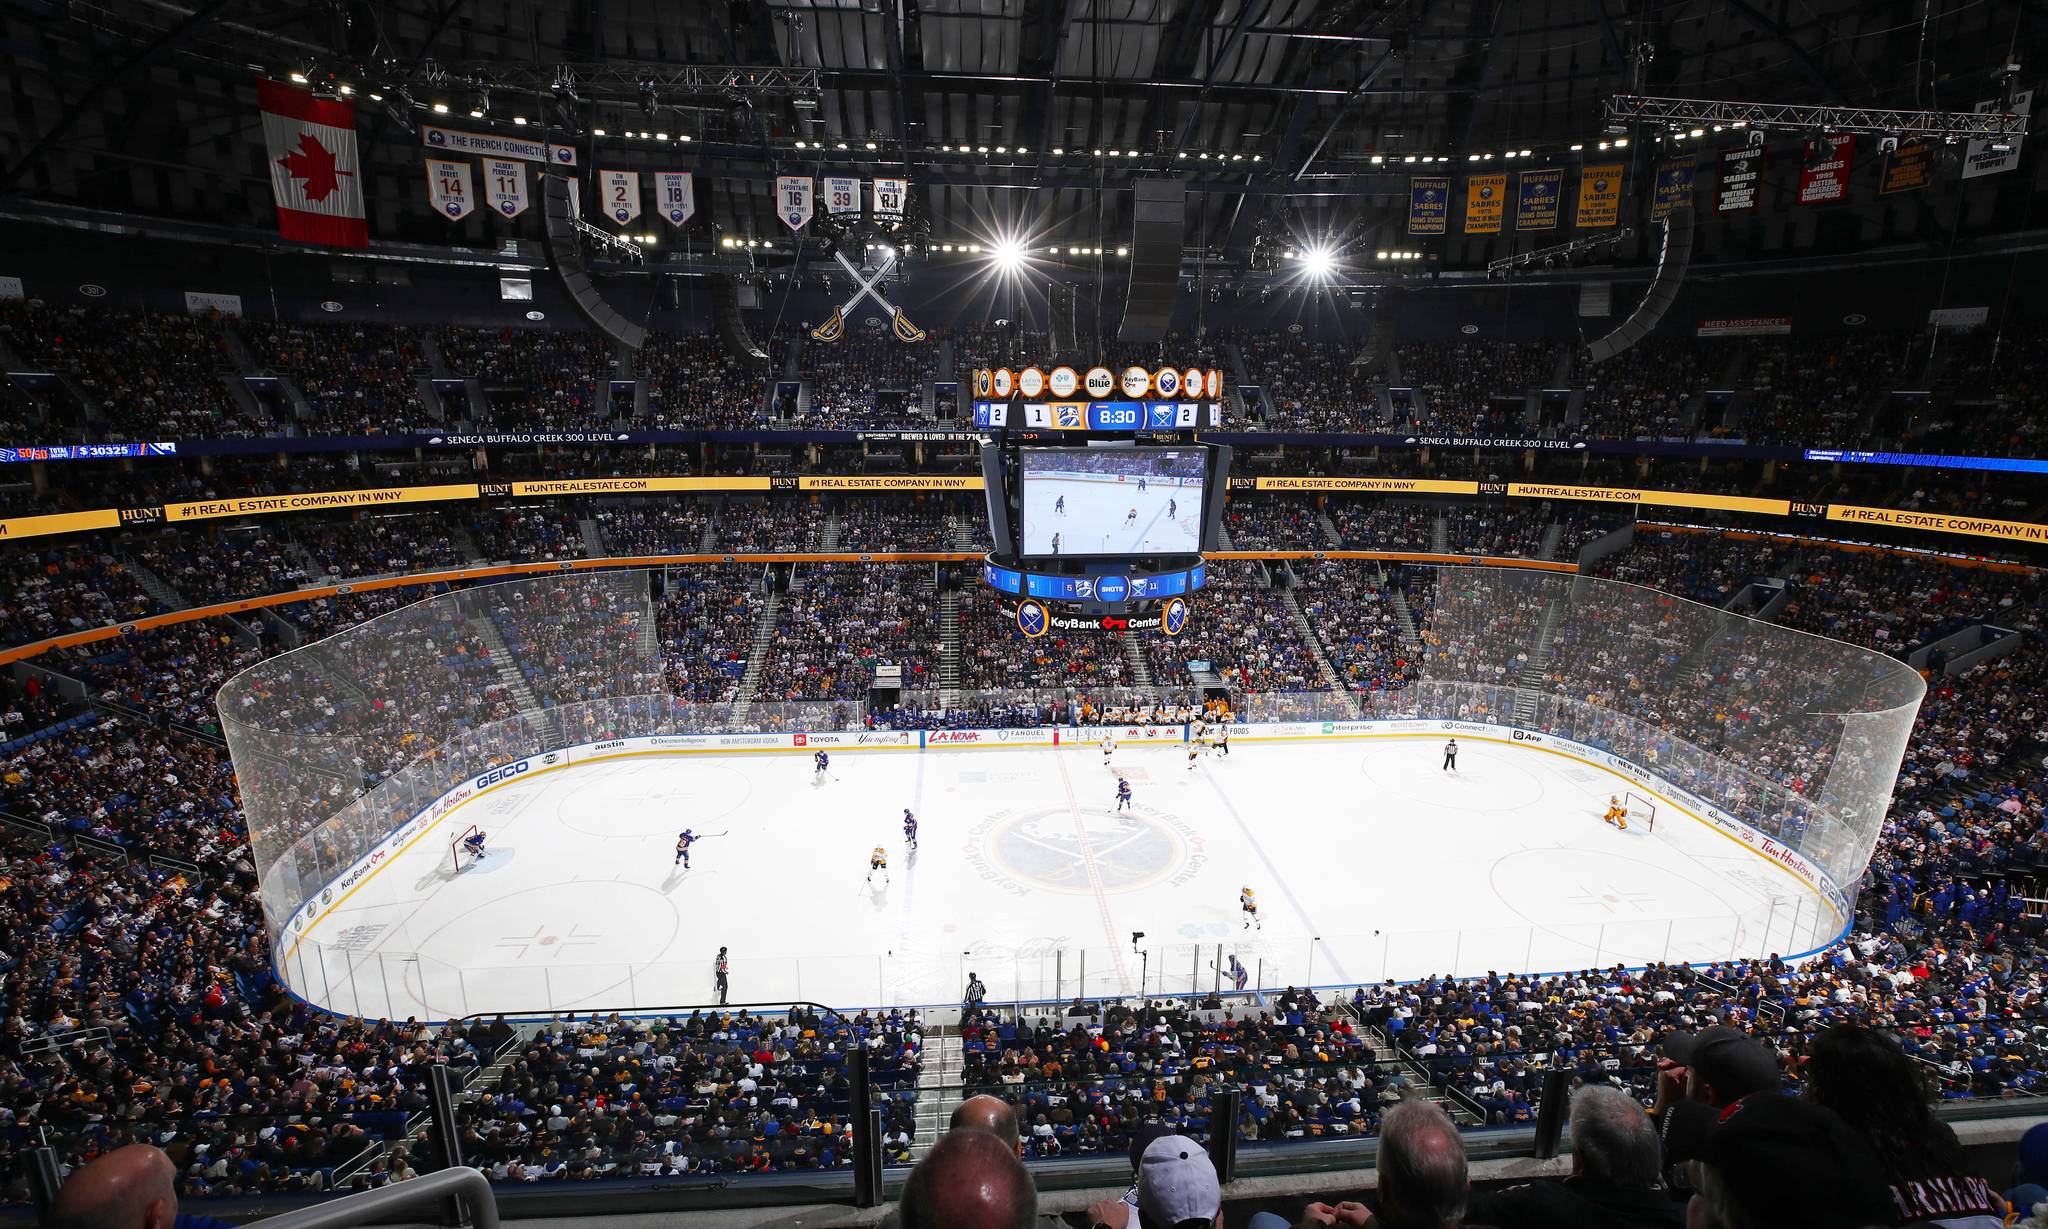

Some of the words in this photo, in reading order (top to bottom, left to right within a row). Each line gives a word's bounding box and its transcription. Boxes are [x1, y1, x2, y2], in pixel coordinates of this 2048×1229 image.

[452, 136, 467, 146] THE
[470, 138, 502, 150] FRENCH
[504, 142, 554, 160] CONNECTI
[1725, 149, 1761, 161] BUFFALO
[1975, 158, 2006, 170] TROPHY
[1524, 174, 1559, 183] BUFFALO
[1724, 172, 1757, 183] SABRES
[1809, 178, 1837, 188] EASTERN
[440, 178, 463, 196] 14
[497, 177, 517, 194] 11
[1660, 183, 1692, 193] SABRES
[1803, 184, 1842, 195] CONFERENCE
[615, 187, 626, 201] 2
[668, 188, 682, 202] 18
[1721, 188, 1755, 198] NORTHEAST
[1802, 191, 1840, 201] CHAMPIONS
[788, 192, 802, 206] 16
[833, 192, 851, 206] 39
[882, 194, 898, 208] RJ
[1523, 196, 1555, 205] SABRES
[1719, 201, 1753, 211] CHAMPIONS
[1728, 318, 1786, 328] ASSISTANCE?
[1089, 378, 1110, 387] Blue
[995, 410, 1000, 421] 2
[1035, 410, 1042, 422] 1
[1100, 411, 1136, 423] 8:30
[1183, 410, 1189, 421] 2
[447, 435, 485, 444] SENECA
[487, 434, 531, 443] BUFFALO
[534, 434, 564, 442] CREEK
[1494, 439, 1521, 447] CREEK
[18, 448, 48, 459] 50/50
[80, 446, 87, 456] $
[91, 446, 128, 456] 30325
[524, 481, 648, 492] HUNTREALESTATE.COM
[772, 478, 798, 487] HUNT
[1480, 483, 1507, 491] HUNT
[481, 484, 510, 493] HUNT
[1518, 486, 1641, 500] HUNTREALESTATE.COM
[182, 506, 197, 516] #1
[202, 503, 236, 514] REAL
[239, 500, 288, 512] ESTATE
[291, 494, 354, 507] COMPANY
[358, 493, 370, 502] IN
[373, 492, 402, 501] WNY
[1792, 503, 1826, 514] HUNT
[121, 508, 160, 520] HUNT
[1842, 509, 1856, 518] #1
[1859, 511, 1892, 521] REAL
[1896, 514, 1944, 528] ESTATE
[1948, 520, 2024, 536] COMPANY
[2026, 527, 2041, 538] IN
[1051, 618, 1100, 630] KeyBank
[1128, 617, 1161, 629] Center
[857, 733, 899, 744] Yuengling
[928, 731, 949, 742] LA
[950, 731, 980, 741] NOVA
[595, 740, 624, 750] austin
[477, 761, 528, 789] GEICO
[1618, 760, 1632, 770] NEW
[1634, 766, 1651, 780] WAVE
[431, 804, 443, 820] Tim
[443, 788, 471, 814] Hortons
[1708, 809, 1739, 832] Wegmans
[1761, 837, 1780, 857] Tim
[1780, 849, 1815, 881] Hortons
[341, 862, 371, 890] KeyBank
